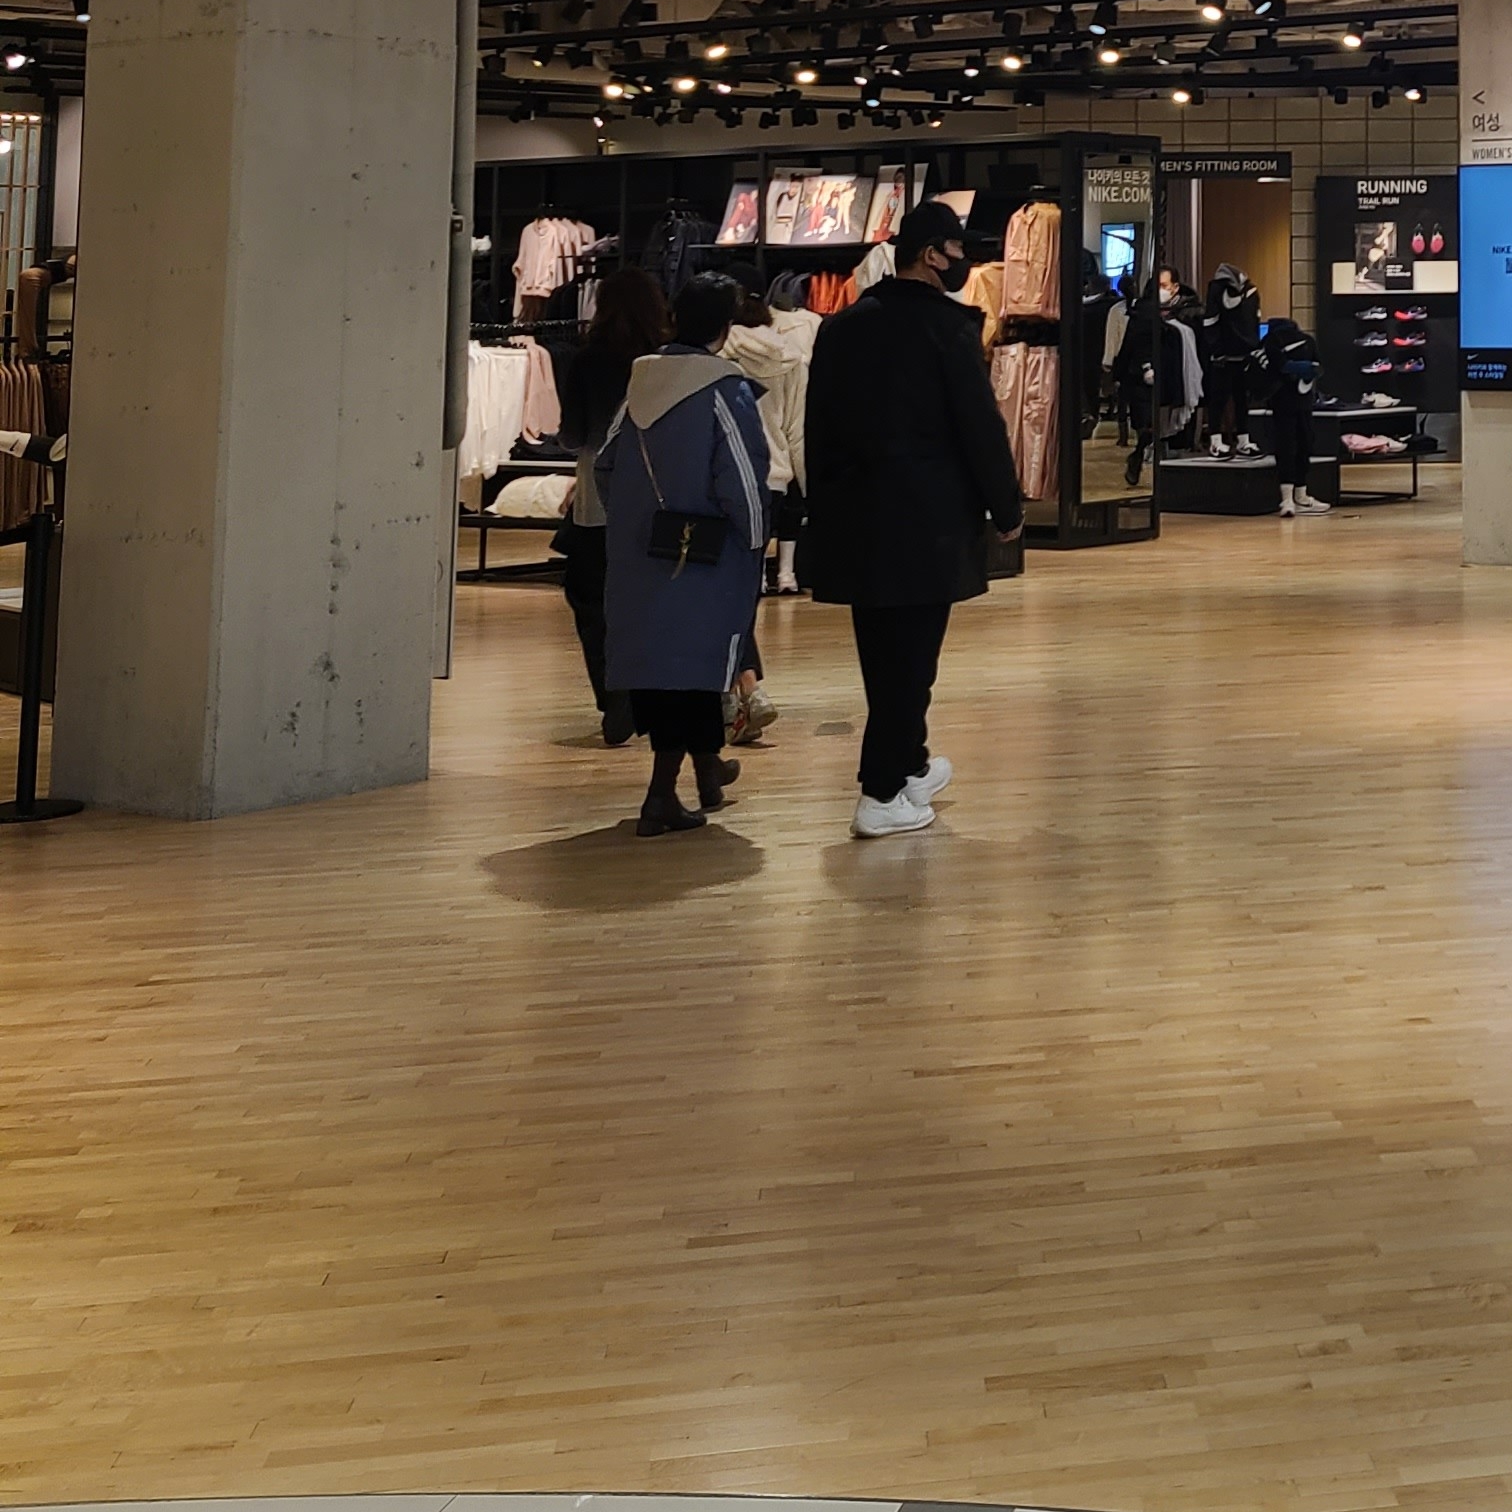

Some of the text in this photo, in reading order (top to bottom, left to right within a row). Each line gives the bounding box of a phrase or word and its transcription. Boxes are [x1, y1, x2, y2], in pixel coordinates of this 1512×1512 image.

[1472, 112, 1501, 132] 여성
[1472, 147, 1512, 160] WOMEN'S
[1195, 160, 1241, 172] FITTING
[1244, 160, 1278, 172] ROOM
[1088, 169, 1122, 185] 나이키의
[1088, 185, 1150, 203] NIKE.COM
[1357, 179, 1428, 194] RUNNING
[1357, 196, 1400, 205] TRAIL RUN
